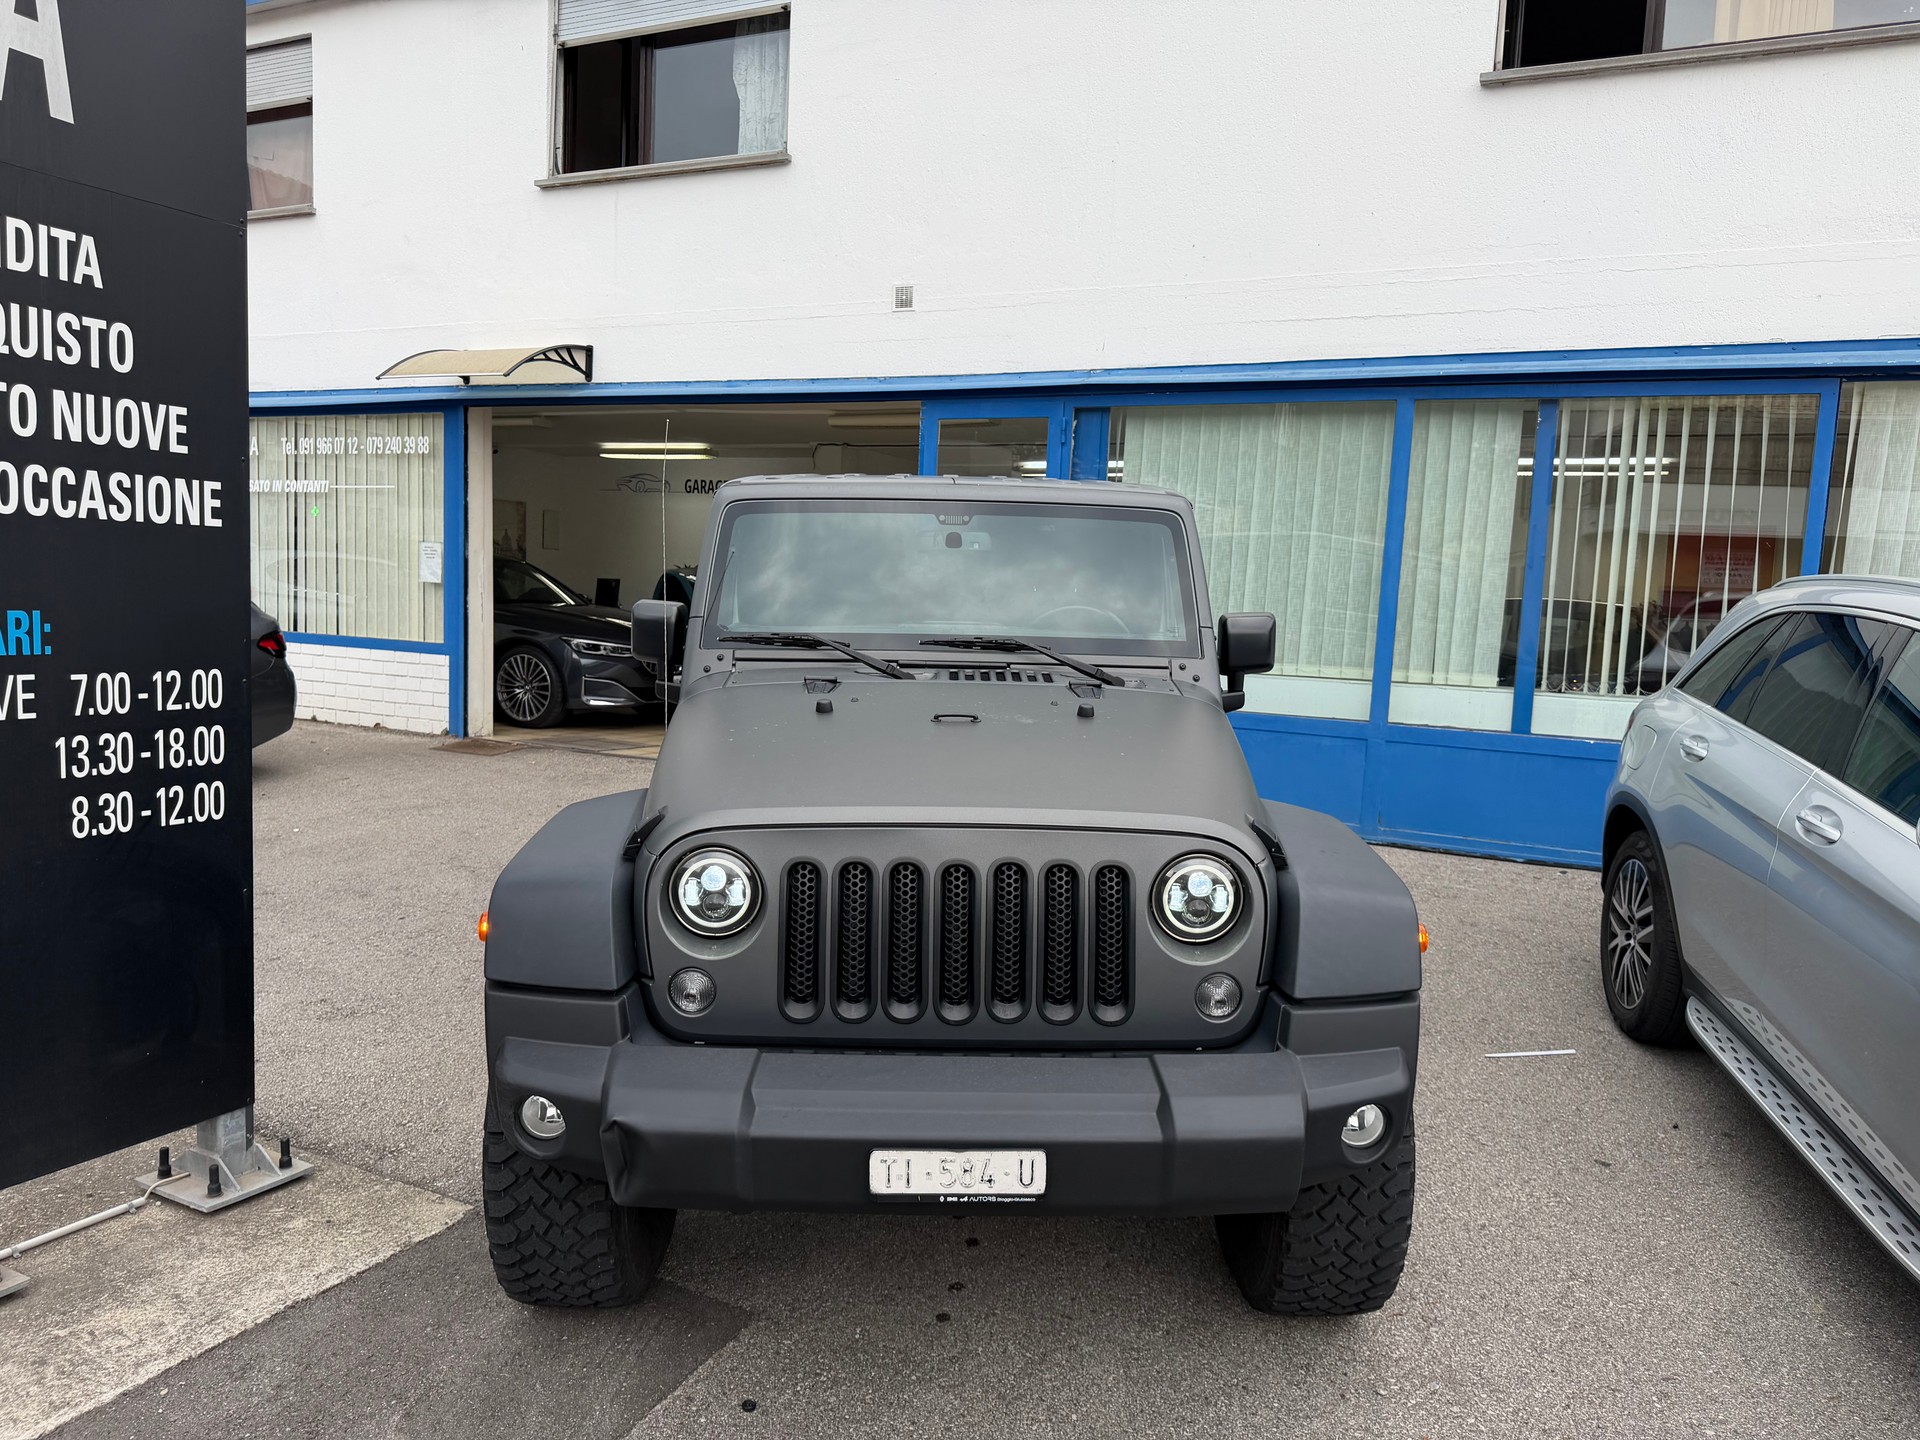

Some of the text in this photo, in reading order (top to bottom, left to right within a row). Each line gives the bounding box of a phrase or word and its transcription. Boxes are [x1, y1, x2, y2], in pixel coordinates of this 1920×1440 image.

[0, 0, 74, 124] A
[0, 216, 103, 289] DITA
[53, 389, 188, 454] NUOVE
[281, 437, 297, 454] Tel.
[299, 437, 314, 454] 091
[316, 437, 332, 454] 966
[334, 437, 345, 454] 07
[347, 437, 358, 454] 12
[367, 436, 383, 454] 079
[385, 436, 402, 454] 240
[404, 436, 415, 454] 39
[417, 436, 429, 454] 88
[0, 461, 223, 527] OCCASIONE
[272, 479, 282, 493] IN
[284, 479, 329, 493] CONTANTI
[684, 479, 728, 494] GARA
[0, 610, 52, 656] RI:
[70, 671, 131, 716] 7.00
[152, 668, 223, 711] 12.00
[55, 731, 134, 779] 13.30
[154, 724, 225, 770] 18.00
[71, 790, 134, 839] 8.30
[156, 780, 225, 827] 12.00
